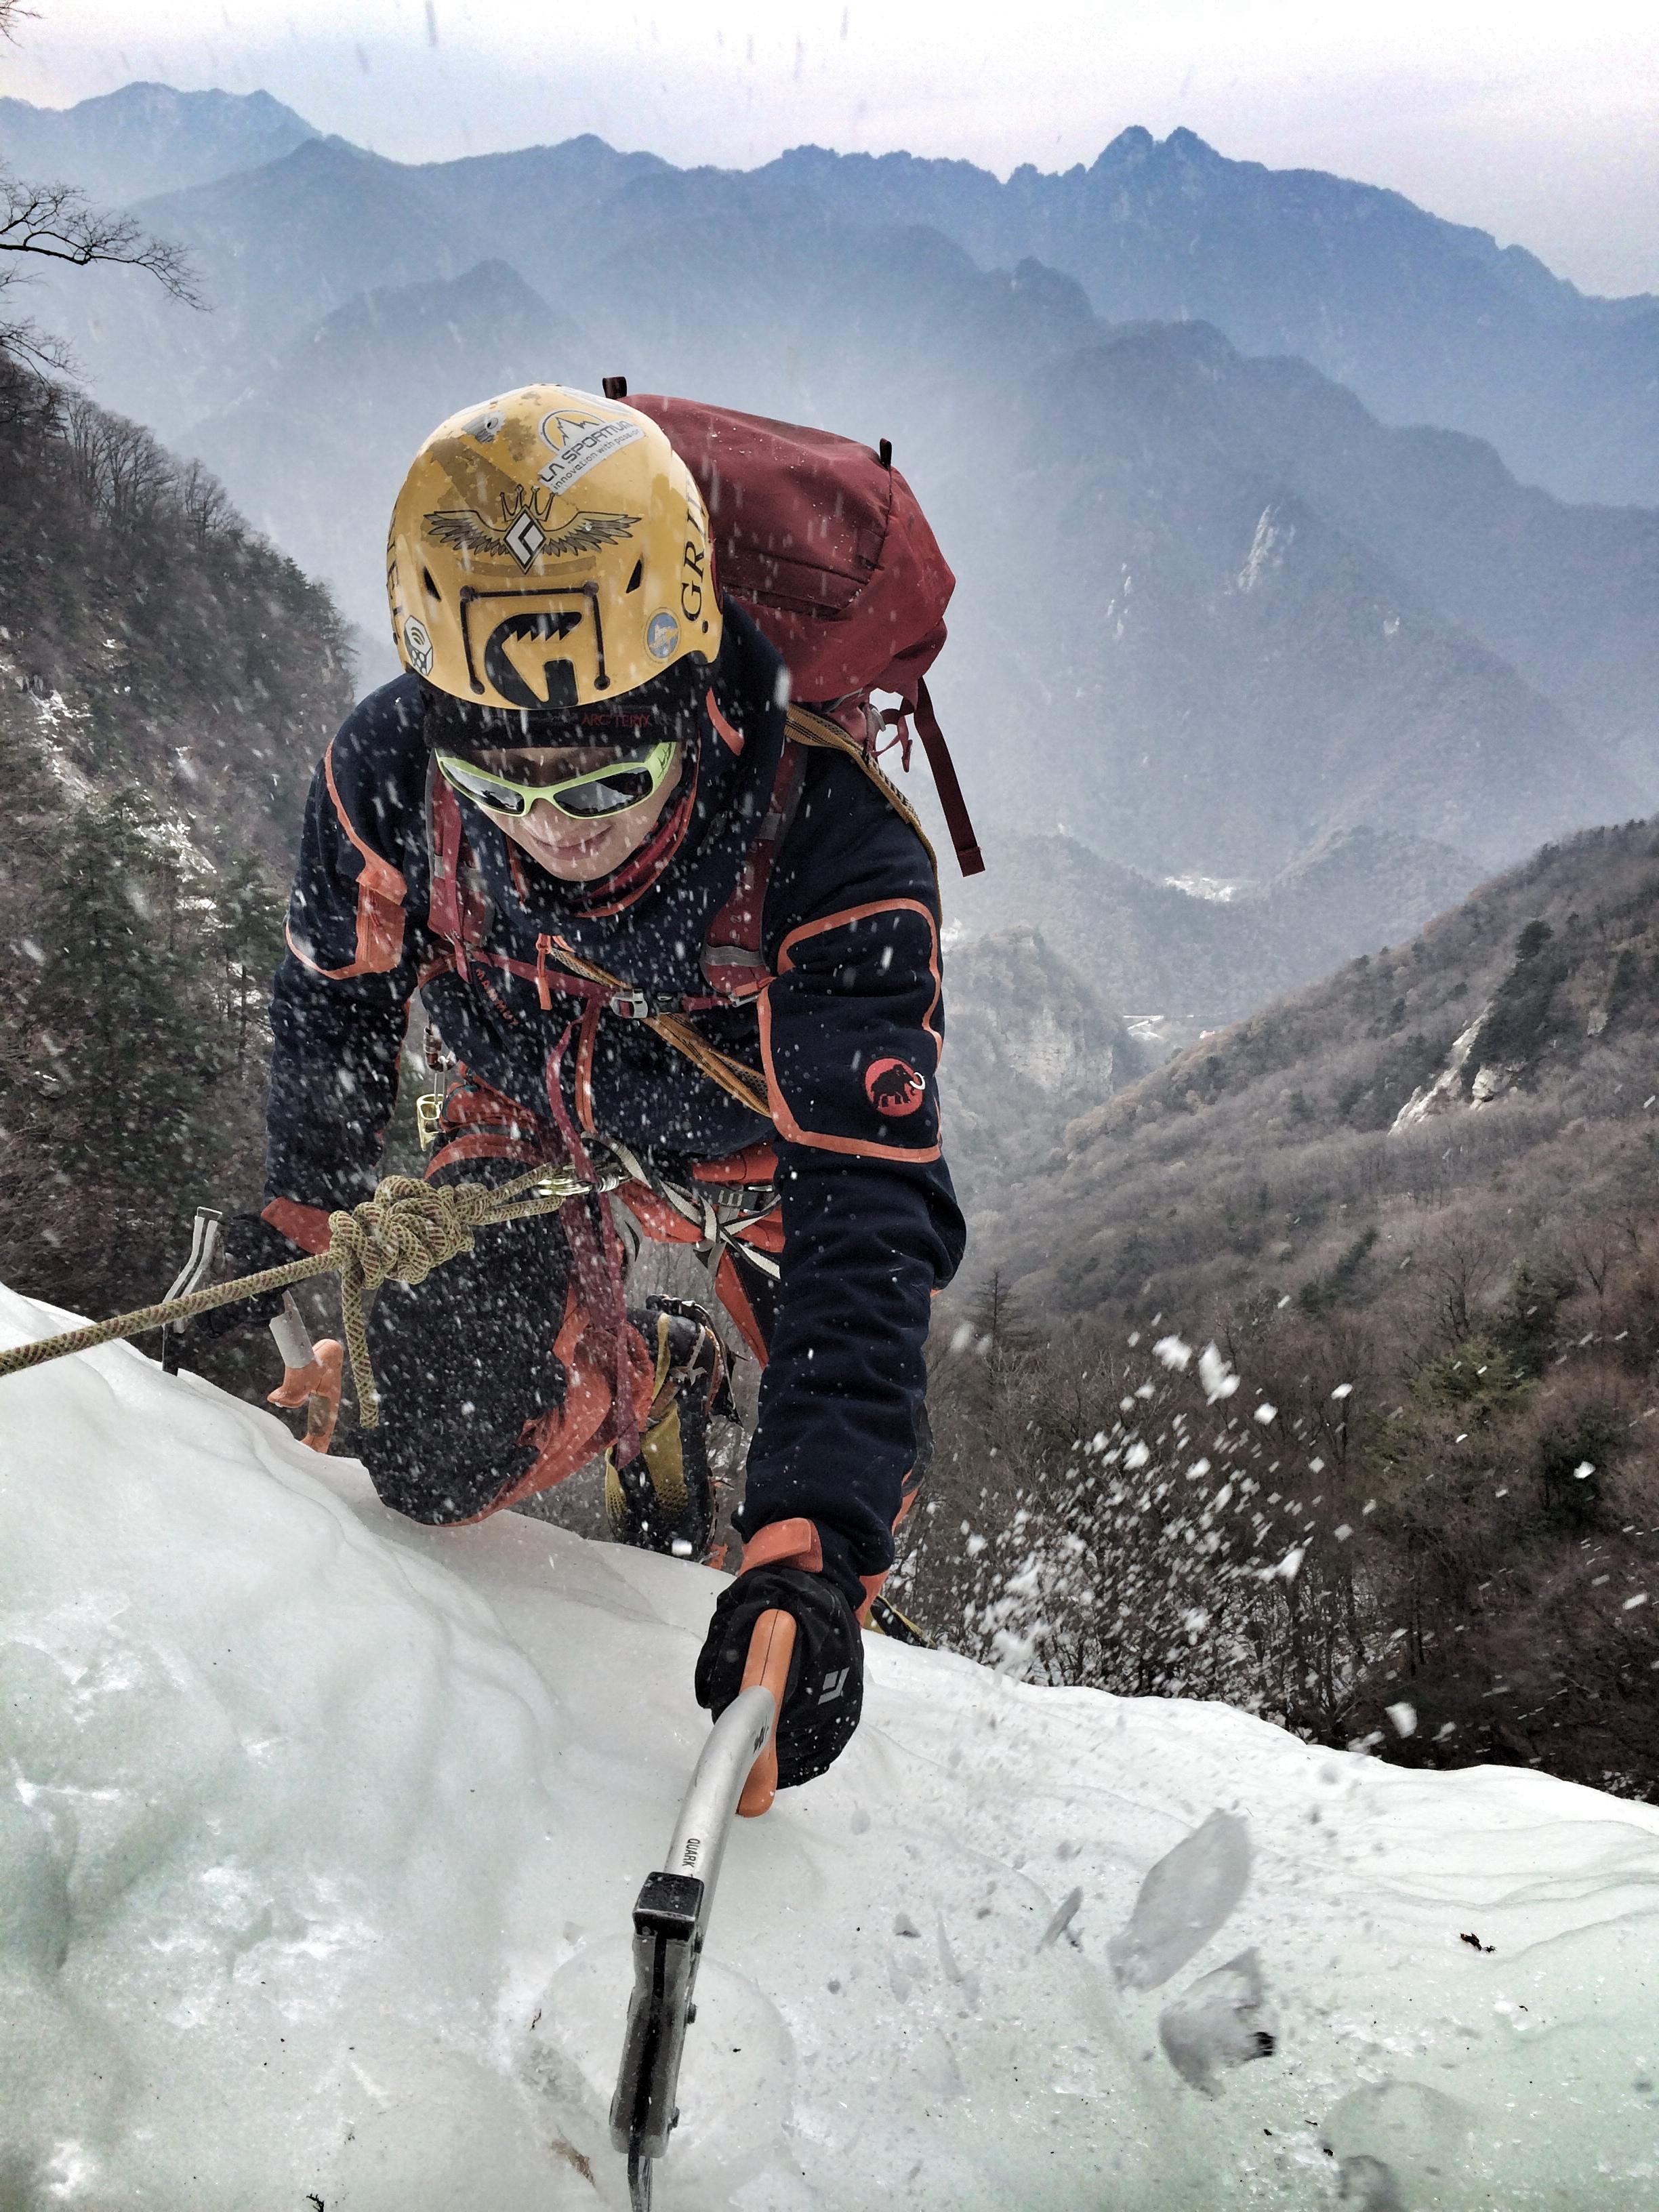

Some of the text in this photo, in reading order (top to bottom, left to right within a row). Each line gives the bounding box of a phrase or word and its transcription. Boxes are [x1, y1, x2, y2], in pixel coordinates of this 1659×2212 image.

[541, 420, 634, 482] LA SPORTIVA
[551, 452, 598, 489] innovation
[596, 440, 616, 454] with
[682, 1838, 701, 1868] QUARK
